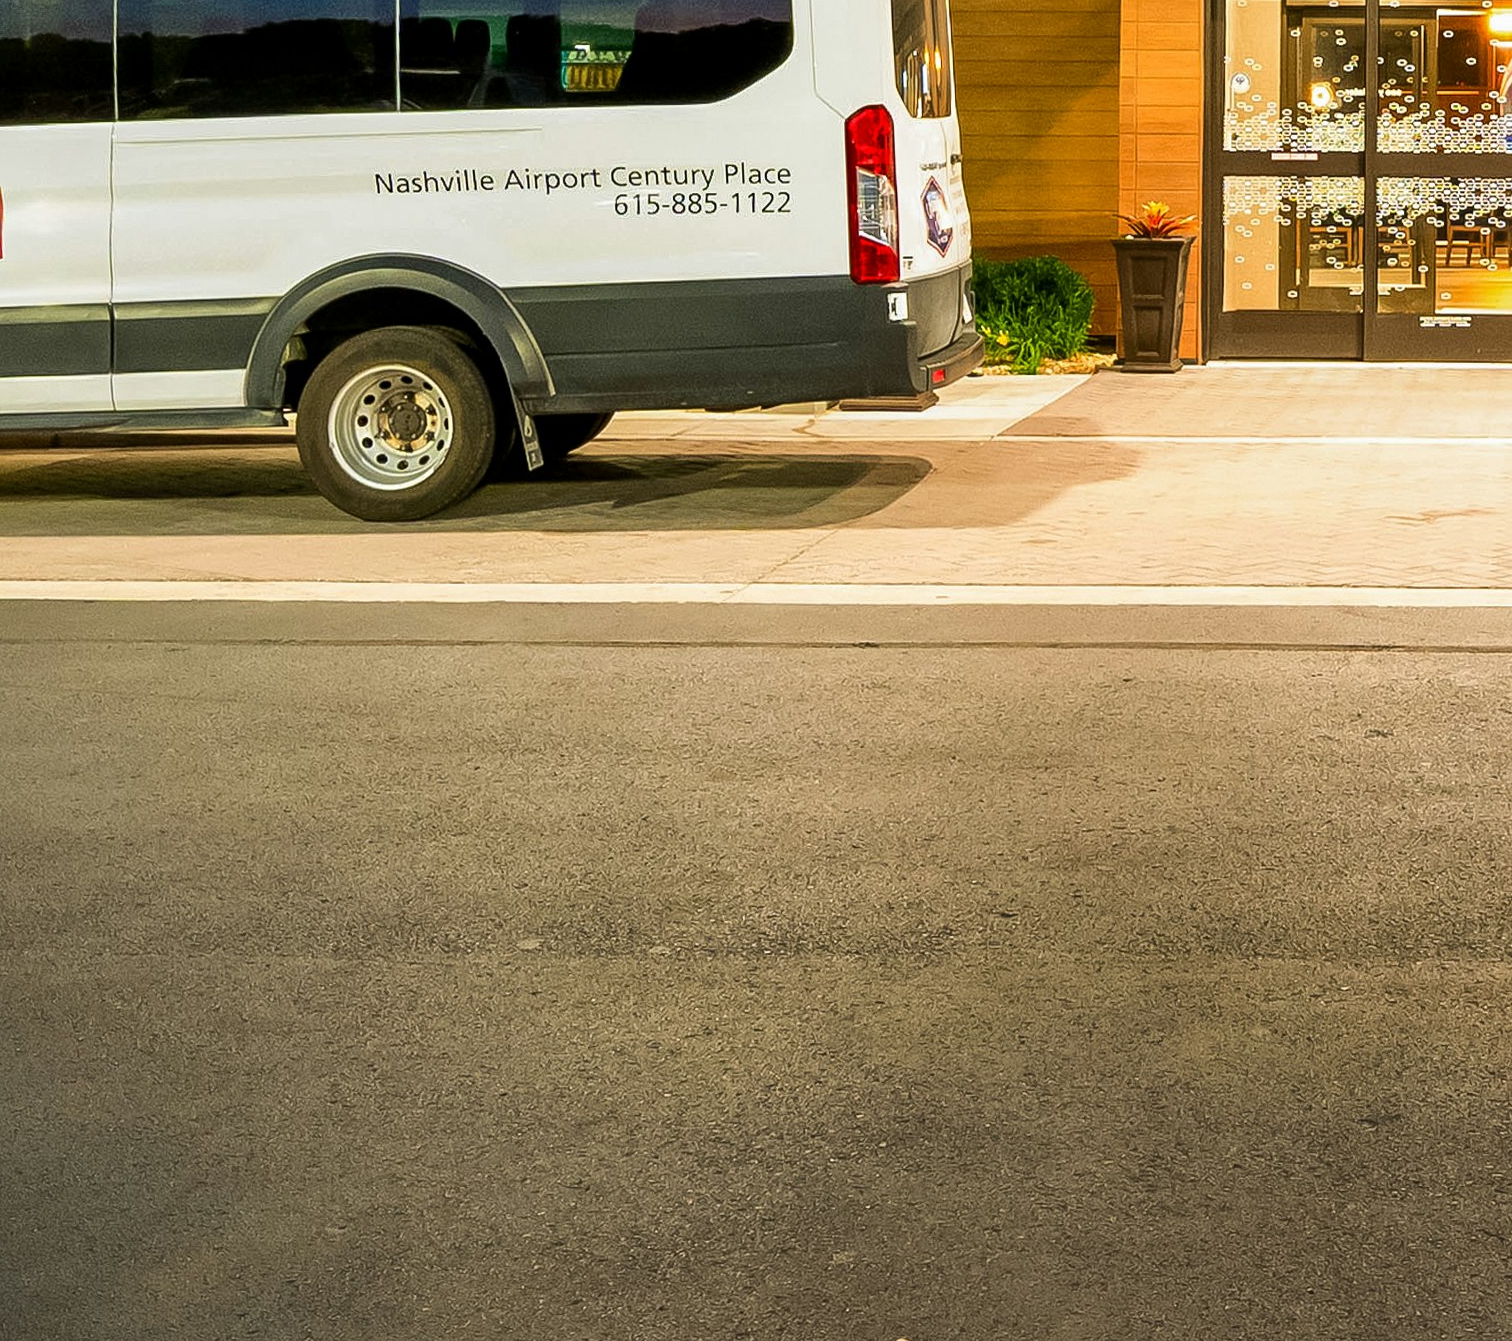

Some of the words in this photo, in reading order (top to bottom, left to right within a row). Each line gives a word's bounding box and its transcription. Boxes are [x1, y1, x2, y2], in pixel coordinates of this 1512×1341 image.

[374, 169, 494, 194] Nashville
[504, 168, 602, 195] Airport
[610, 166, 715, 191] Century
[724, 162, 792, 185] Place
[613, 191, 792, 216] 615-885-1122
